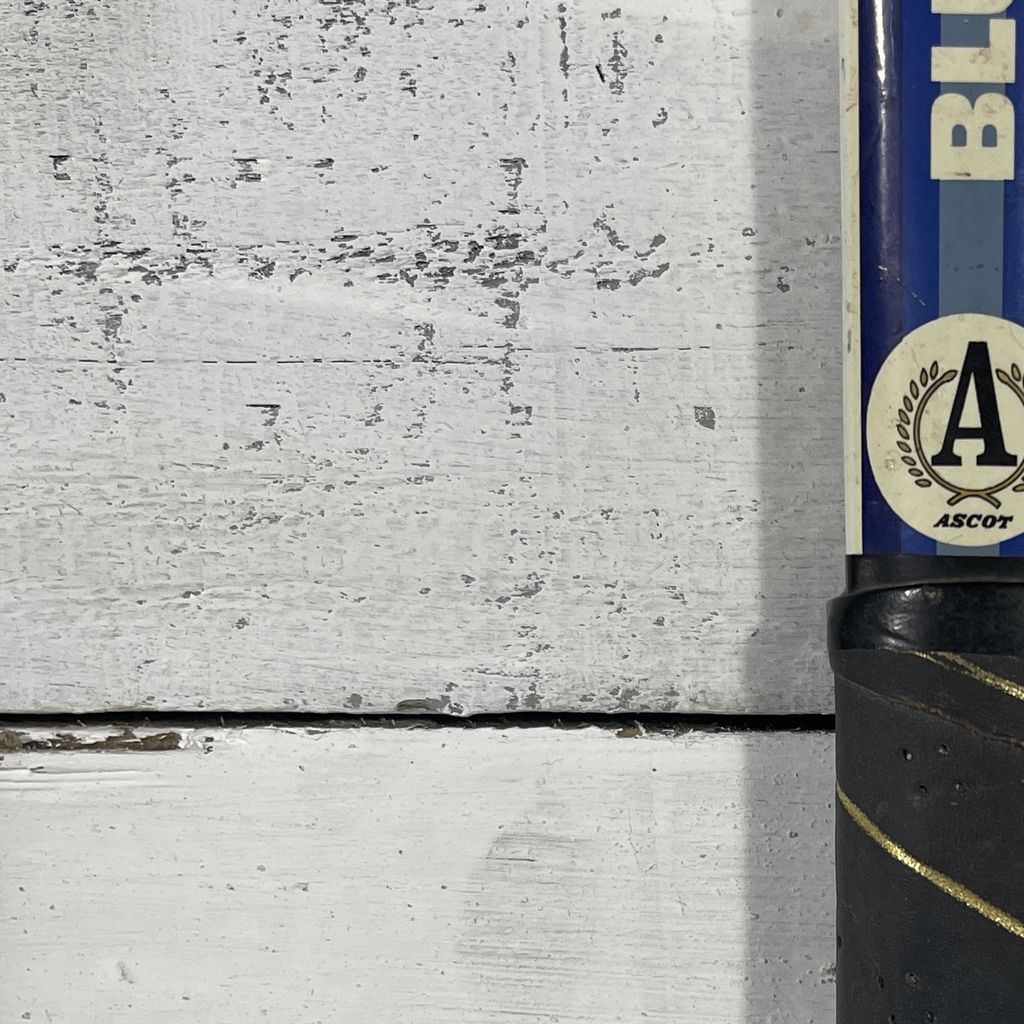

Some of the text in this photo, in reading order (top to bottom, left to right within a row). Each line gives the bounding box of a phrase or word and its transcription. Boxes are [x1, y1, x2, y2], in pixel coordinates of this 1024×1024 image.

[930, 0, 1017, 181] BL
[931, 341, 1018, 467] A
[933, 513, 1014, 530] ASCOT
